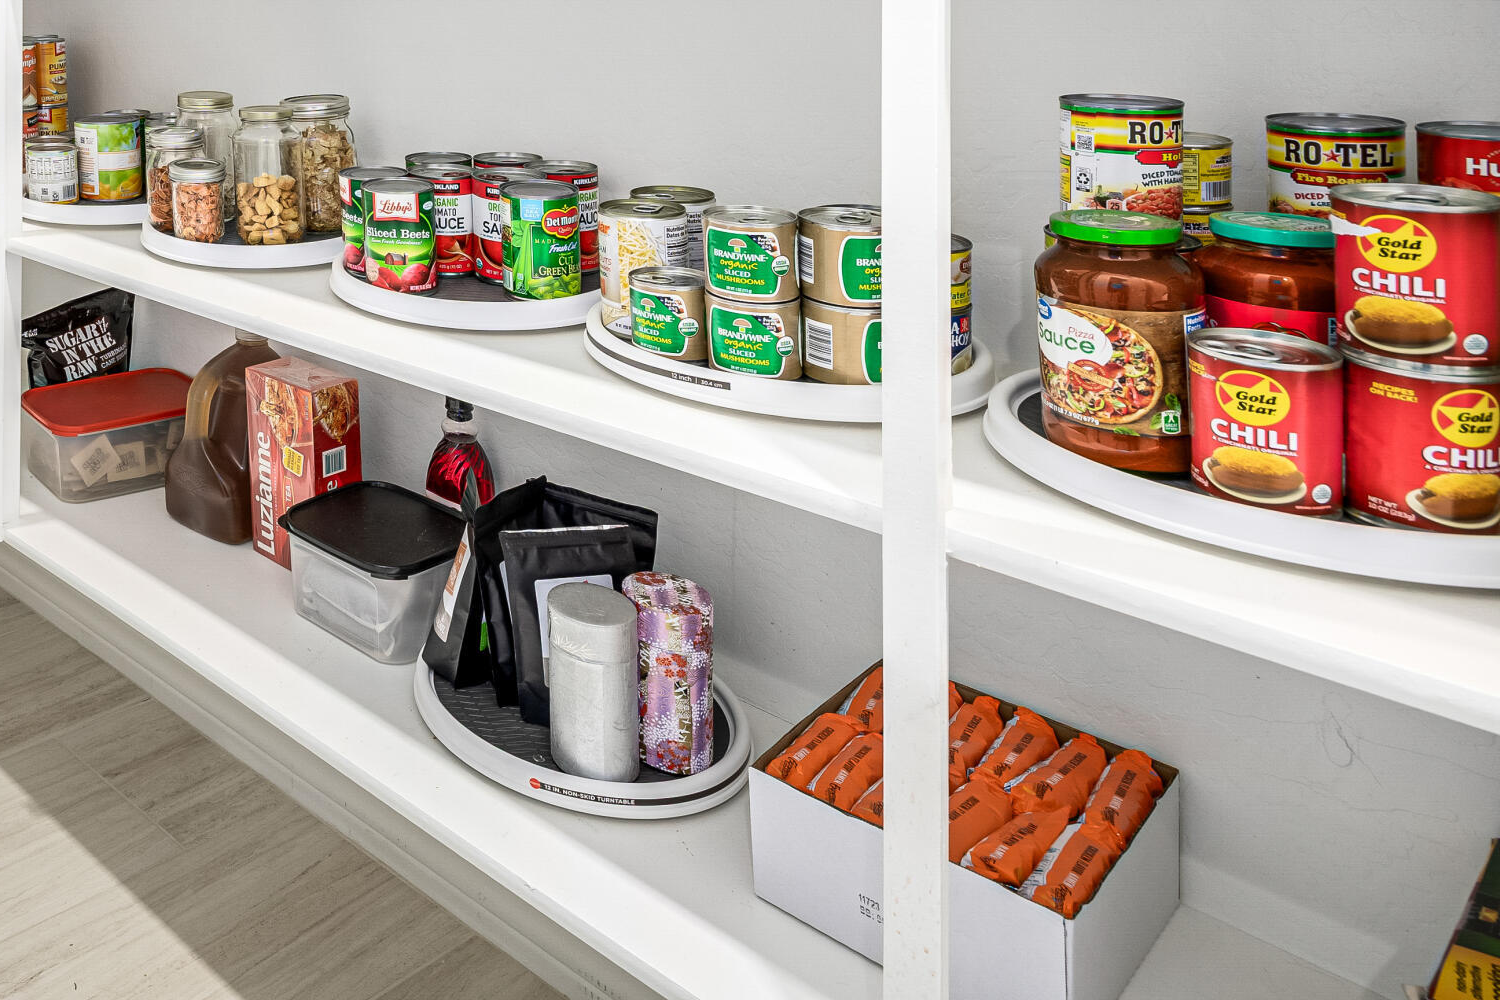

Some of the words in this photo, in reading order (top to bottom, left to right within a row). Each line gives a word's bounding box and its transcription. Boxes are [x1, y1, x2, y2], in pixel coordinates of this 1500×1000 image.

[1161, 153, 1182, 162] Hot
[1141, 171, 1166, 180] DICED
[1296, 172, 1325, 184] Fire
[1141, 179, 1164, 188] WITH
[1294, 191, 1324, 201] DICED
[379, 200, 413, 214] Libby's
[1109, 202, 1120, 210] 25
[546, 217, 560, 227] Del
[366, 226, 397, 239] Sliced
[400, 229, 430, 239] Beets
[548, 243, 567, 254] Fresh
[566, 241, 578, 250] Cut
[1376, 236, 1423, 251] Gold
[558, 255, 574, 266] CUT
[713, 248, 769, 264] BRANDYWINE
[1377, 247, 1422, 262] Star
[538, 265, 568, 276] GREEN
[719, 257, 759, 271] organic
[716, 273, 766, 286] MUSHROOMS
[724, 268, 751, 278] SLICED
[1351, 266, 1446, 299] CHILI
[1403, 295, 1446, 304] ORIGINAL
[635, 316, 666, 330] organic
[45, 322, 100, 353] SUGAR
[638, 325, 660, 336] SLICED
[717, 327, 774, 343] BRANDYWINE
[1038, 321, 1096, 354] Sauce
[1067, 326, 1095, 341] Pizza
[60, 346, 81, 365] IN
[80, 331, 117, 358] THE
[724, 338, 764, 351] organic
[720, 352, 770, 367] MUSHROOMS
[728, 347, 756, 359] SLICED
[63, 356, 98, 382] RAW
[671, 372, 678, 380] 12
[678, 374, 693, 383] inch
[1369, 387, 1385, 396] ON
[1385, 389, 1418, 404] BACK!
[1371, 381, 1416, 397] RECIPES
[1235, 390, 1277, 406] Gold
[1236, 401, 1277, 416] Star
[1457, 411, 1494, 423] Gold
[1209, 417, 1298, 451] CHILI
[1458, 421, 1493, 435] Star
[255, 431, 275, 556] Luzianne
[552, 786, 562, 794] IN.
[562, 788, 596, 801] NON-SKID
[596, 796, 636, 805] TURNTABLE
